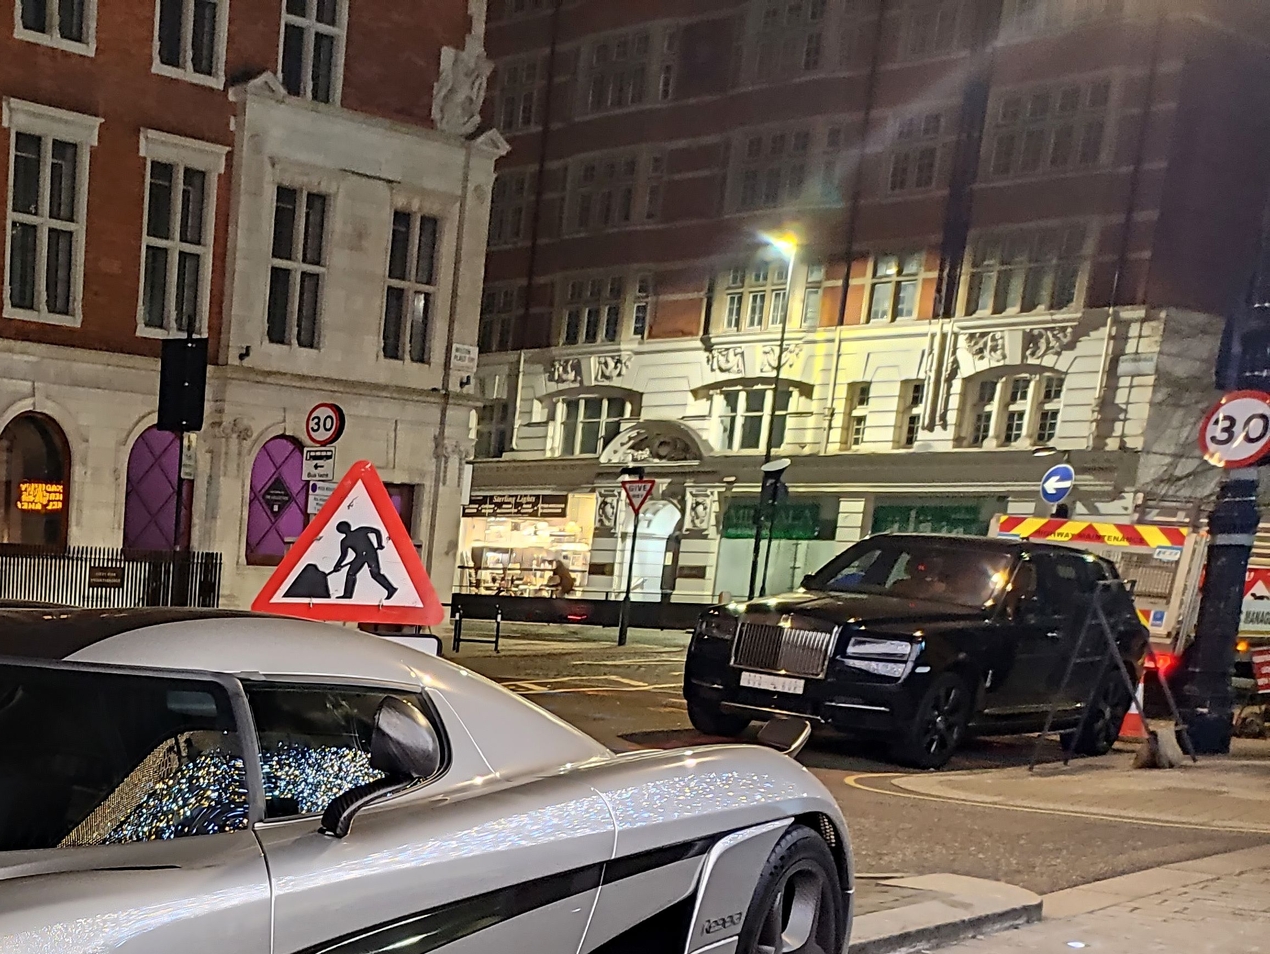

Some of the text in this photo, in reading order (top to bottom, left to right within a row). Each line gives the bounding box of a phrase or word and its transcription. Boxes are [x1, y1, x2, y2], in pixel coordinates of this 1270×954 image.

[310, 415, 334, 433] 30
[1210, 413, 1269, 445] 30
[1078, 533, 1144, 544] MAINTENANCE
